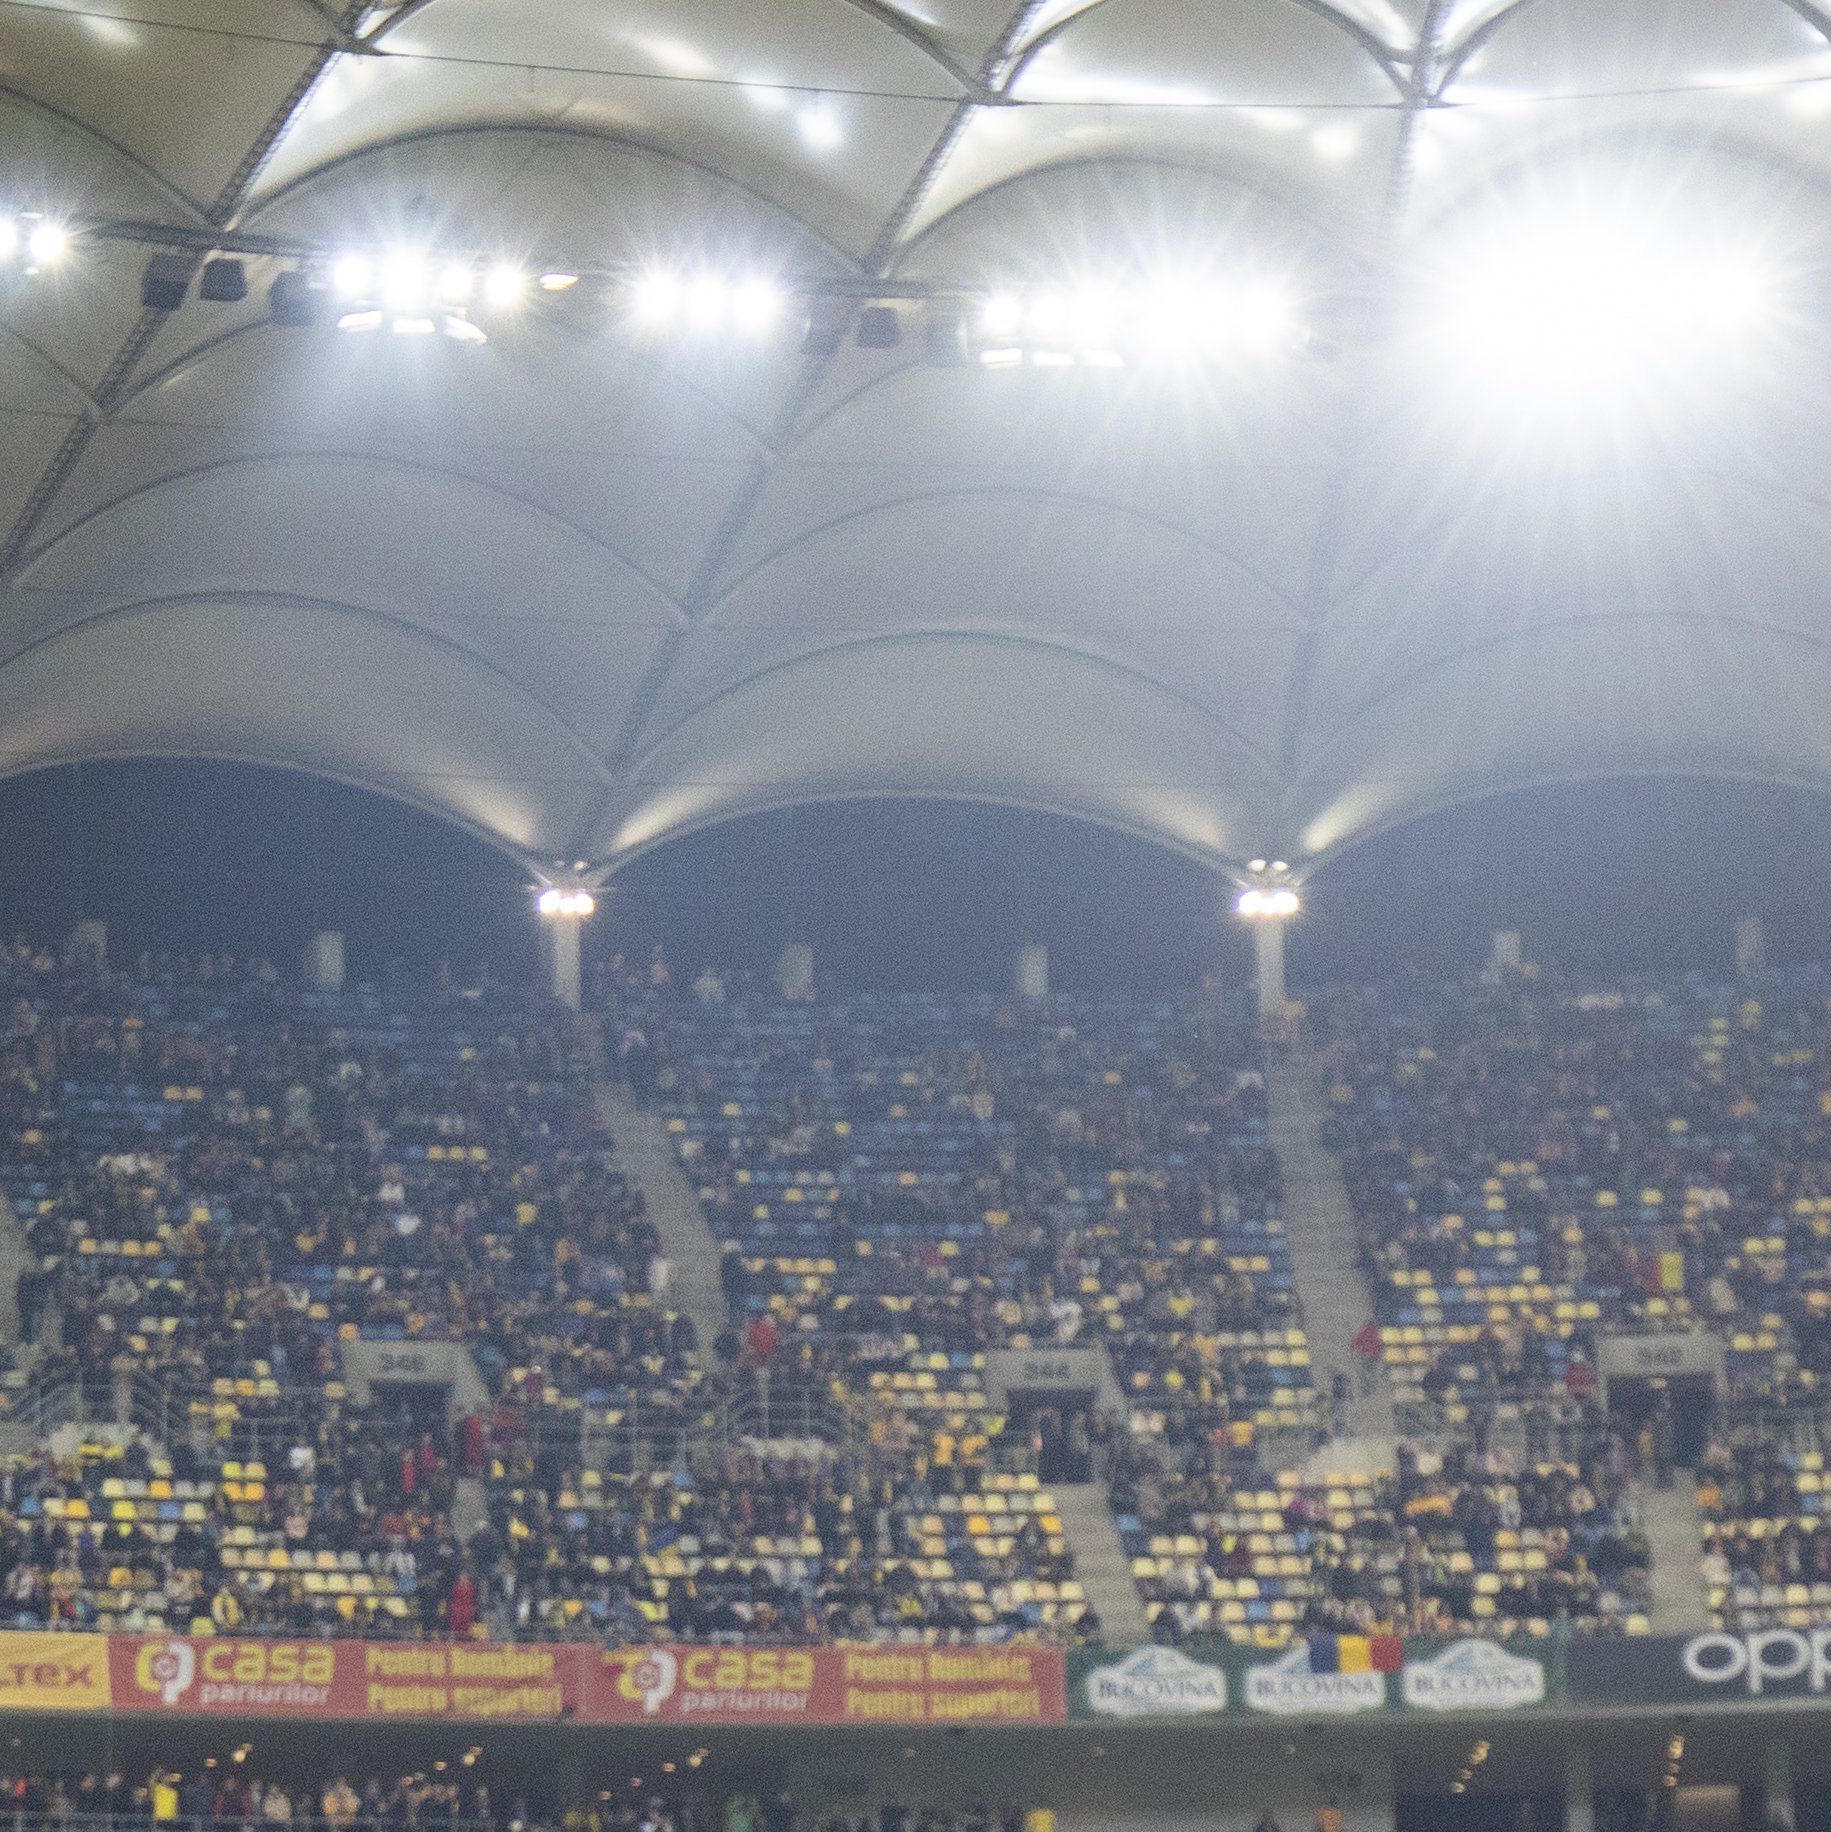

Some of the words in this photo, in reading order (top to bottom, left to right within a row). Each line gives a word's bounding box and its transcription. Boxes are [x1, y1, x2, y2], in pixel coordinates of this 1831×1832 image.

[202, 1643, 335, 1683] casa
[683, 1651, 815, 1690] casa
[1098, 1677, 1219, 1701] BUCOVINA
[1255, 1675, 1379, 1699] BUCOVINA
[1414, 1672, 1536, 1695] BUCOVINA
